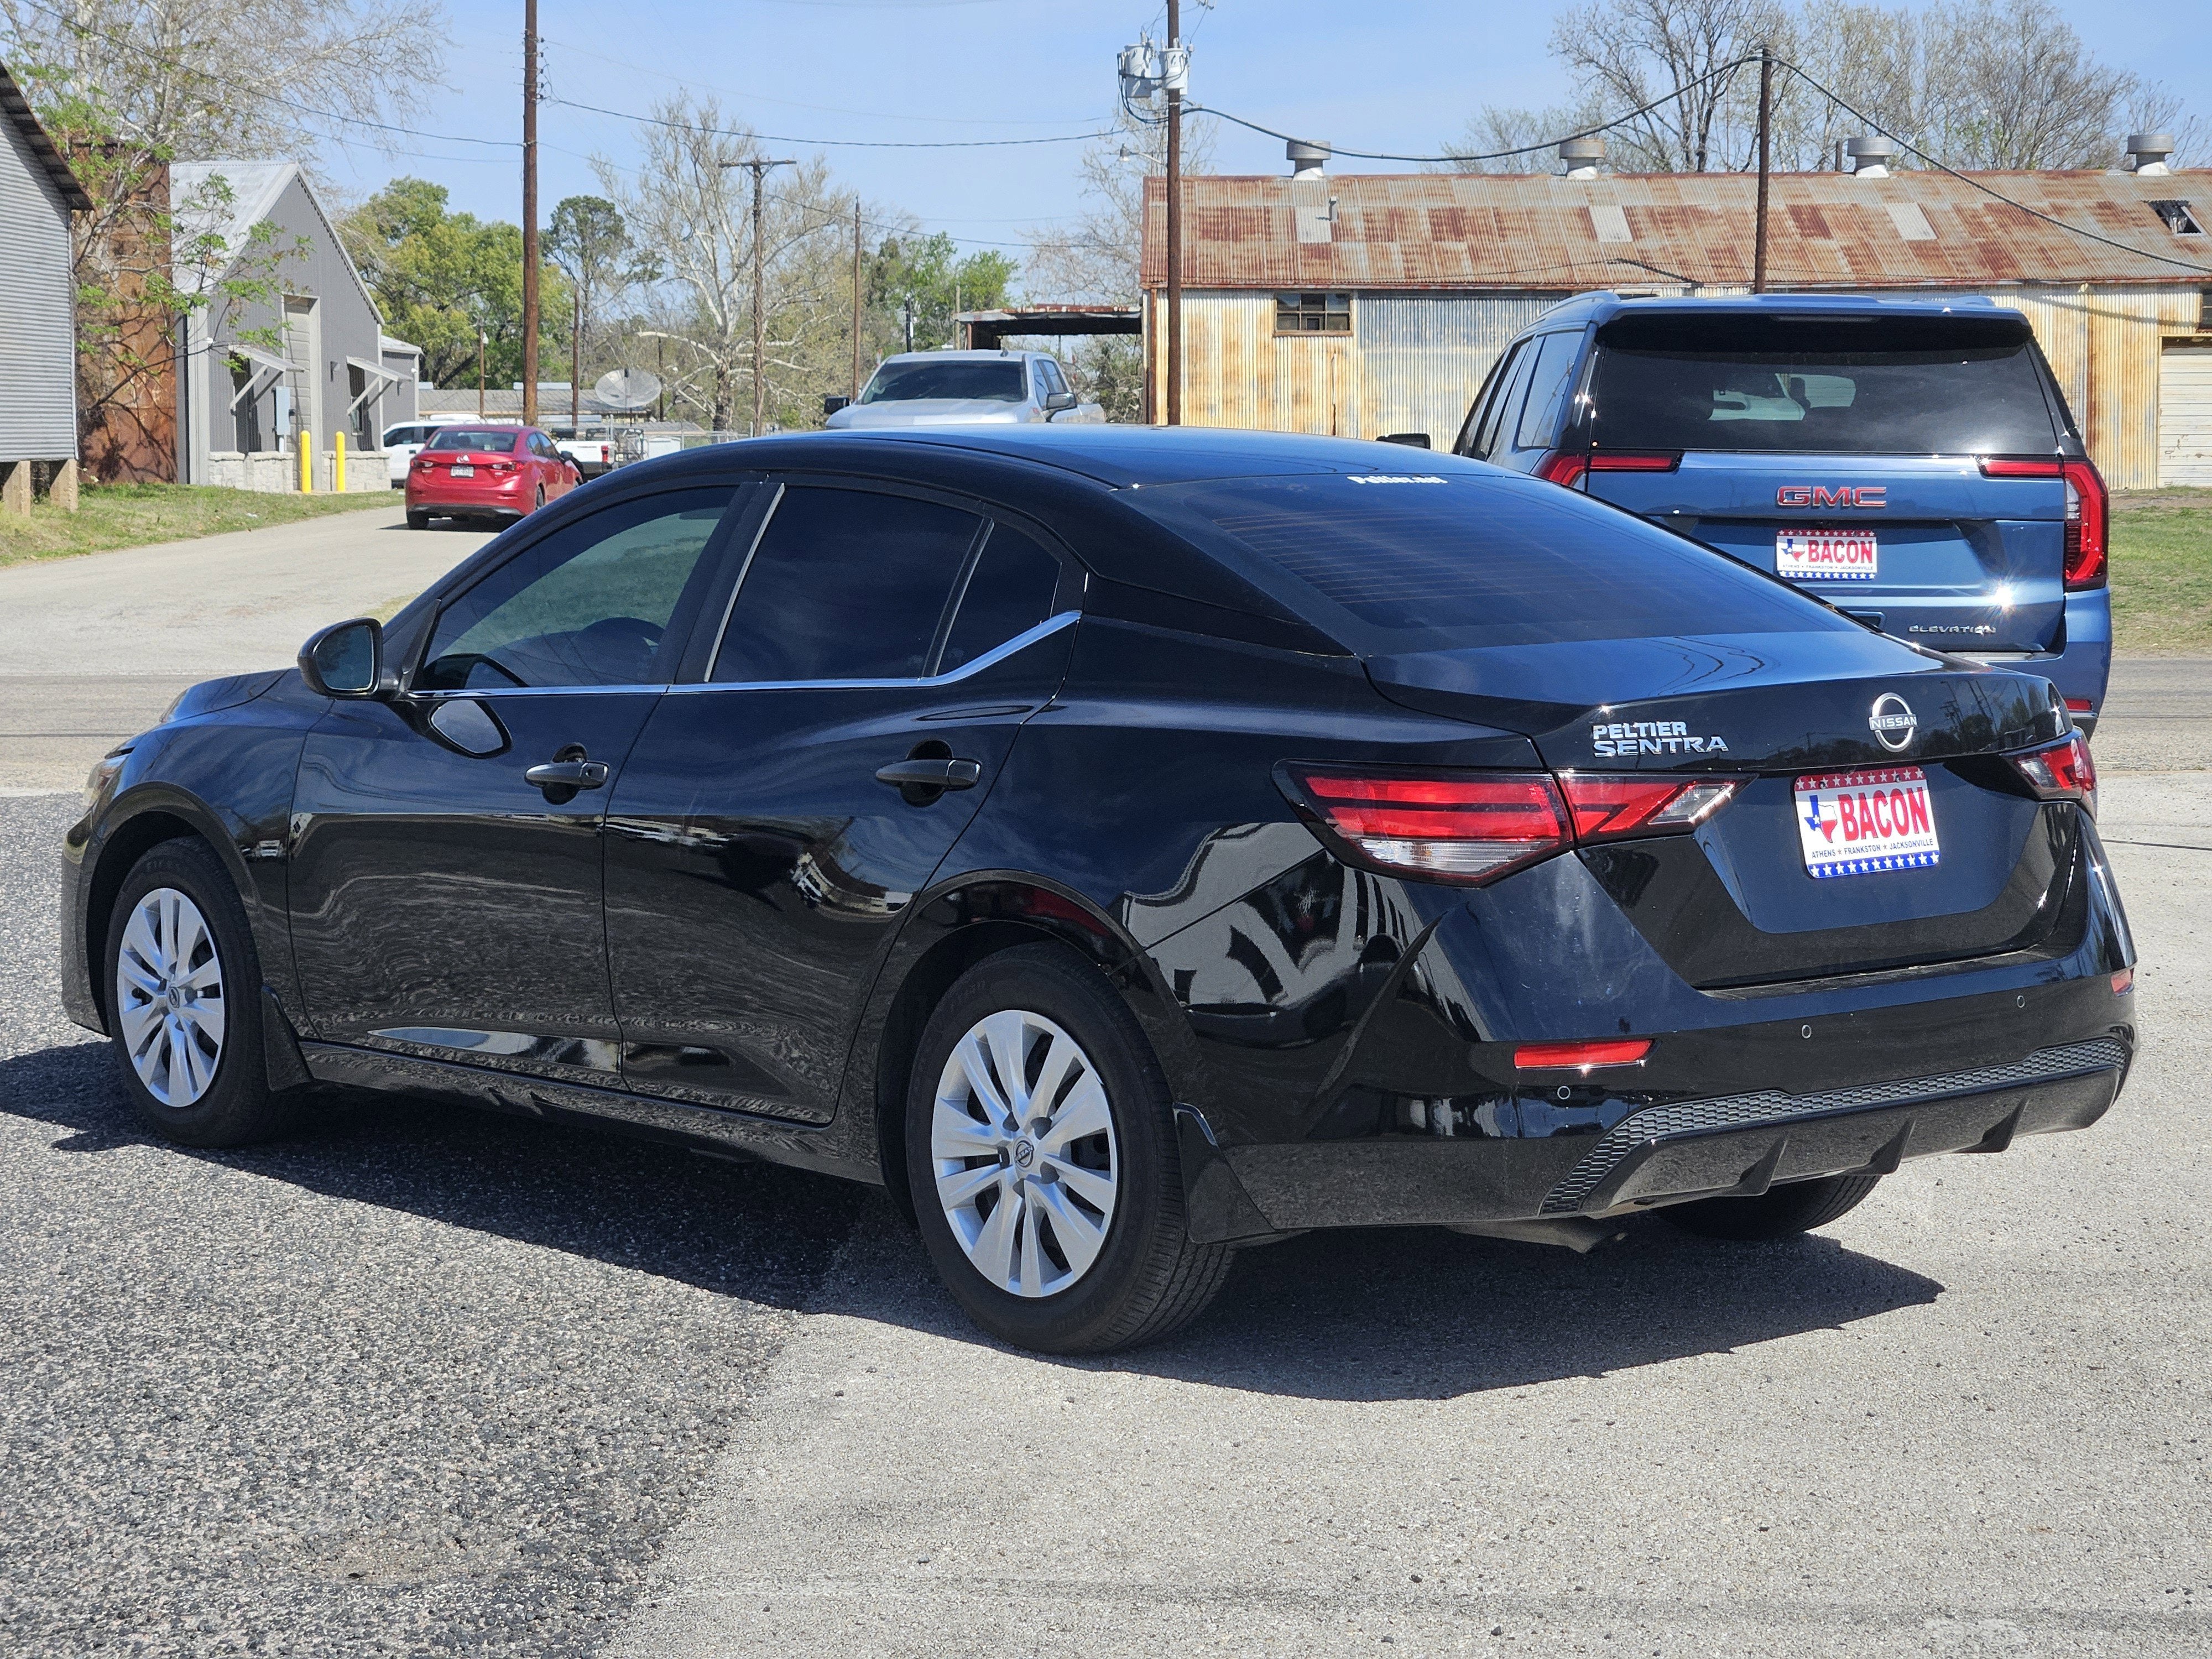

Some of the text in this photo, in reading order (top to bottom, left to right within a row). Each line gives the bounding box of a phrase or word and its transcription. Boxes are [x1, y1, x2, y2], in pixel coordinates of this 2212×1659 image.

[1777, 486, 1886, 507] GMC
[1808, 540, 1872, 564] BACON
[1593, 721, 1687, 739] PELTIER
[1871, 716, 1917, 728] NISSAN
[1593, 736, 1729, 757] SENTRA
[1838, 786, 1930, 842] BACON
[1812, 838, 1934, 858] ATHENS FRANKSTON JACKSONVILLE
